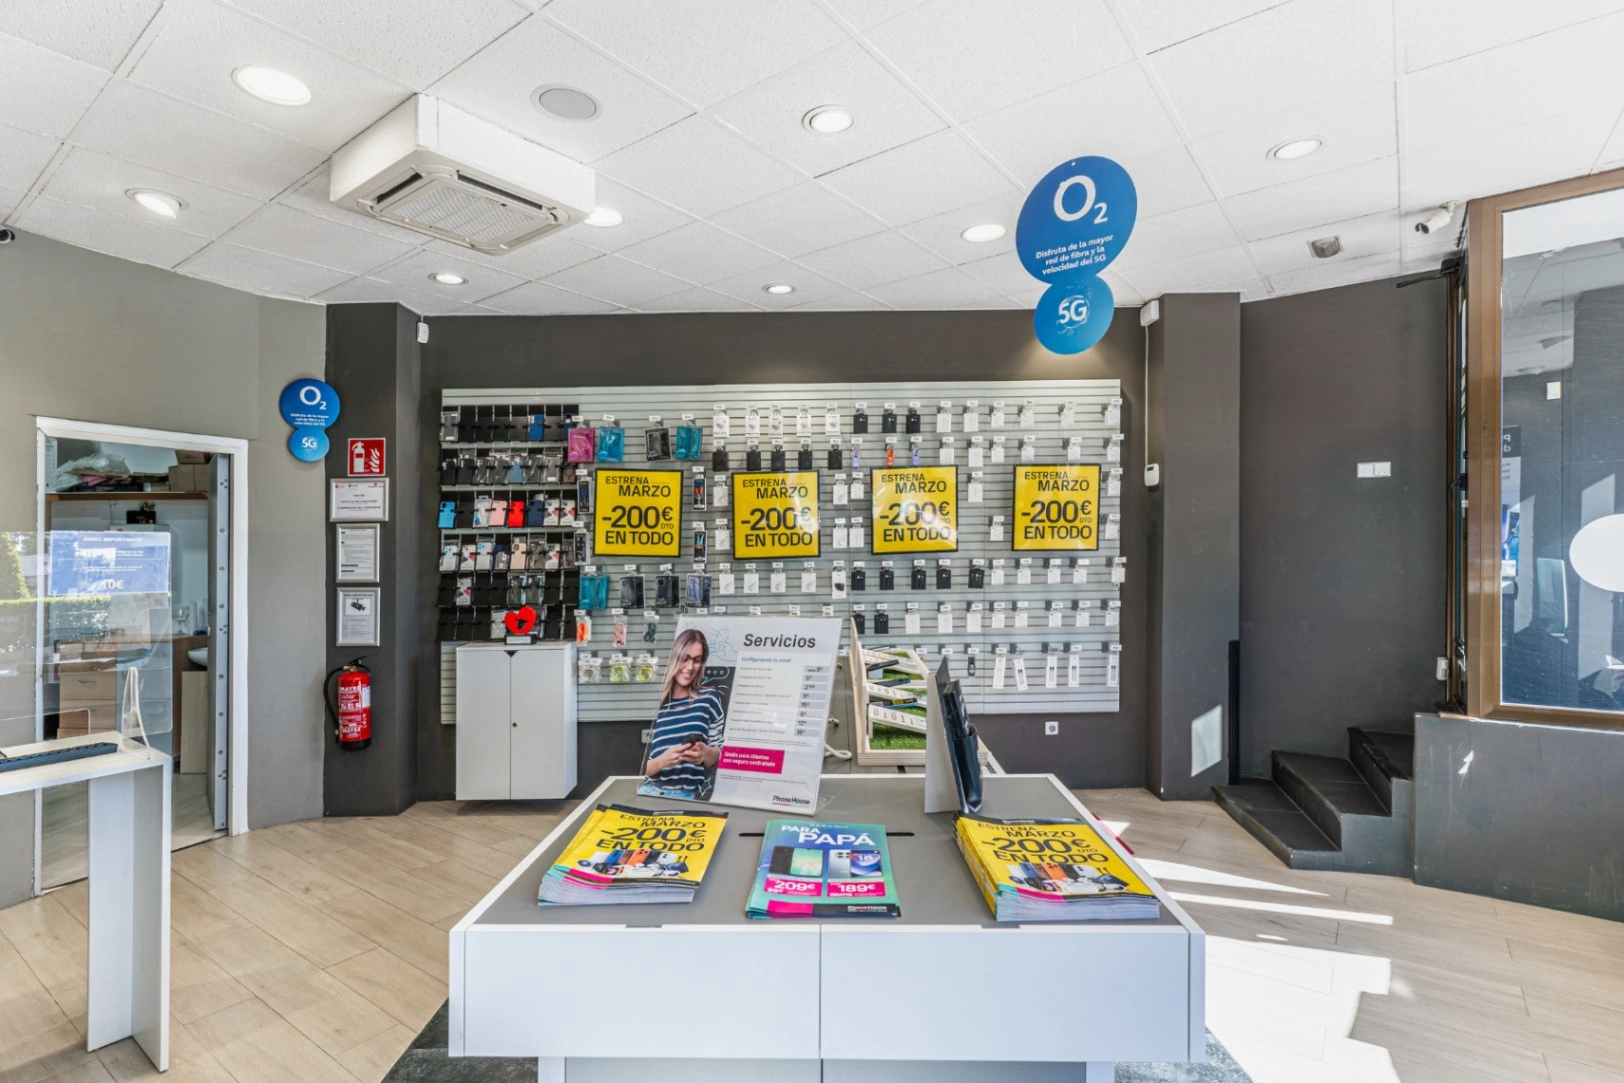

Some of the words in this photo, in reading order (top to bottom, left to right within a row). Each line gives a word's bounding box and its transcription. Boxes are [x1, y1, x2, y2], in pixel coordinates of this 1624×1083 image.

[1035, 246, 1067, 259] Disfruta
[1067, 243, 1078, 251] de
[1088, 235, 1114, 245] mayor
[1045, 256, 1059, 265] red
[1059, 254, 1070, 262] de
[1070, 250, 1090, 259] fibra
[1090, 249, 1096, 257] y
[1042, 260, 1079, 275] velocidad
[1080, 258, 1093, 266] del
[1094, 254, 1106, 263] 5G
[1057, 299, 1088, 324] 5G
[302, 436, 318, 449] 5G
[605, 476, 649, 485] ESTRENA
[881, 473, 925, 483] ESTRENA
[1024, 471, 1069, 480] ESTRENA
[742, 478, 787, 488] ESTRENA
[895, 481, 947, 494] MARZO
[1037, 480, 1090, 492] MARZO
[618, 485, 671, 498] MARZO
[756, 486, 808, 499] MARZO
[605, 531, 630, 545] EN
[631, 532, 674, 546] TODO
[883, 528, 905, 542] EN
[907, 527, 951, 541] TODO
[1024, 526, 1048, 540] EN
[1049, 526, 1092, 540] TODO
[744, 534, 768, 548] EN
[769, 532, 813, 547] TODO
[743, 633, 816, 648] Servicios
[640, 820, 706, 828] MARZO
[781, 825, 821, 834] PARA
[977, 822, 1037, 831] ESTRENA
[798, 832, 876, 846] PAPÁ
[1006, 830, 1076, 838] MARZO
[596, 838, 629, 850] EN
[634, 841, 705, 851] TODO
[993, 850, 1027, 863] EN
[1031, 853, 1109, 864] TODO
[774, 880, 816, 891] 209€
[838, 884, 876, 893] 189€
